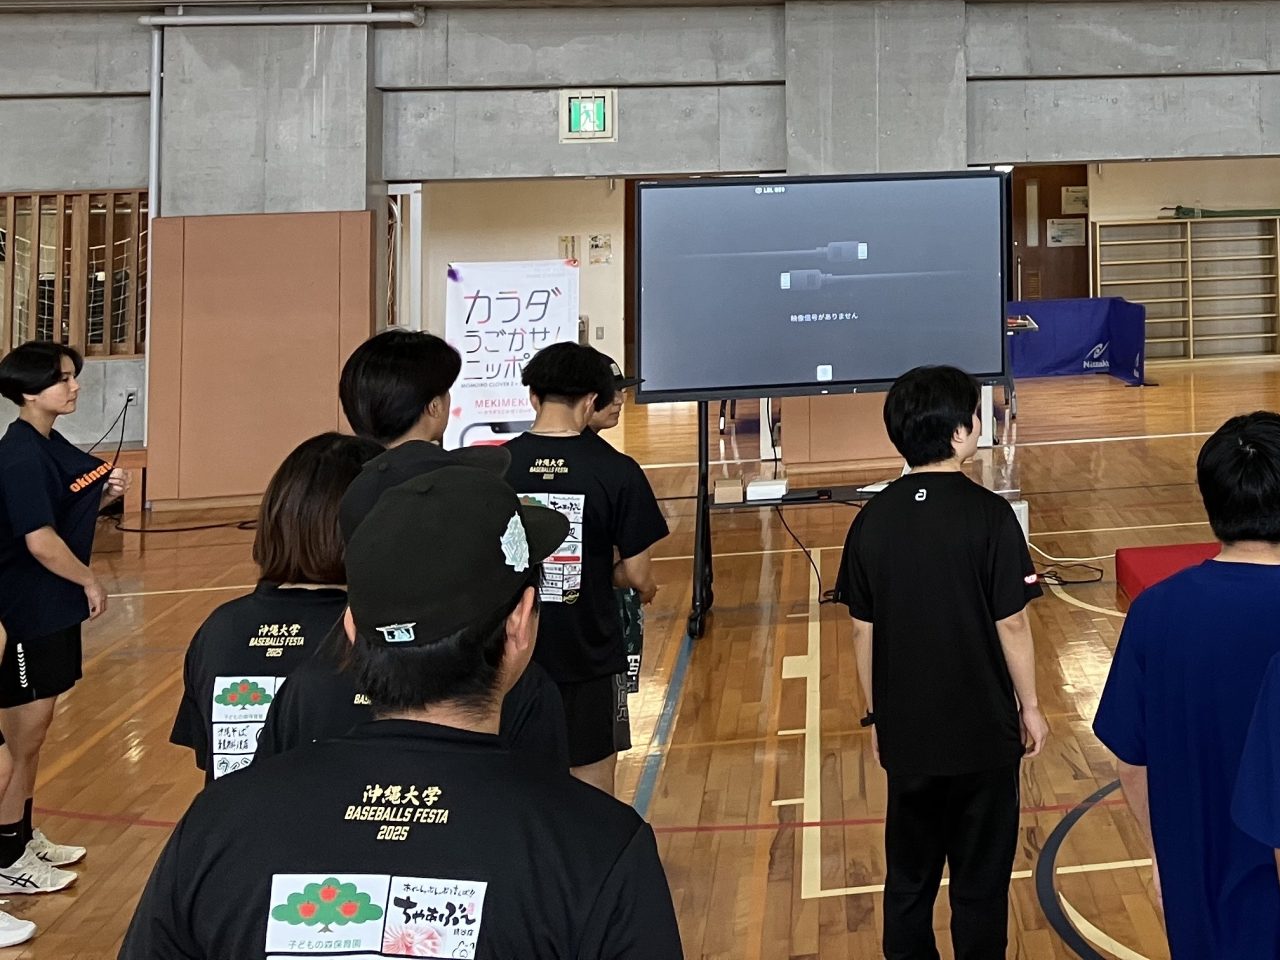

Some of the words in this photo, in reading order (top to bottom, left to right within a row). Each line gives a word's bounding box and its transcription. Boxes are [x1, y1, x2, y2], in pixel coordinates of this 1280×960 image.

[463, 287, 562, 324] カラダ
[475, 398, 528, 408] MEKIMEKI
[258, 623, 301, 636] 沖縄大学
[249, 637, 284, 646] BASEBALLS
[285, 636, 305, 646] FESTA
[362, 784, 442, 806] 沖縄大学
[344, 805, 412, 823] BASEBALLS
[414, 808, 449, 824] FESTA
[376, 825, 409, 841] 2025
[288, 939, 362, 950] 子どもの森保育園
